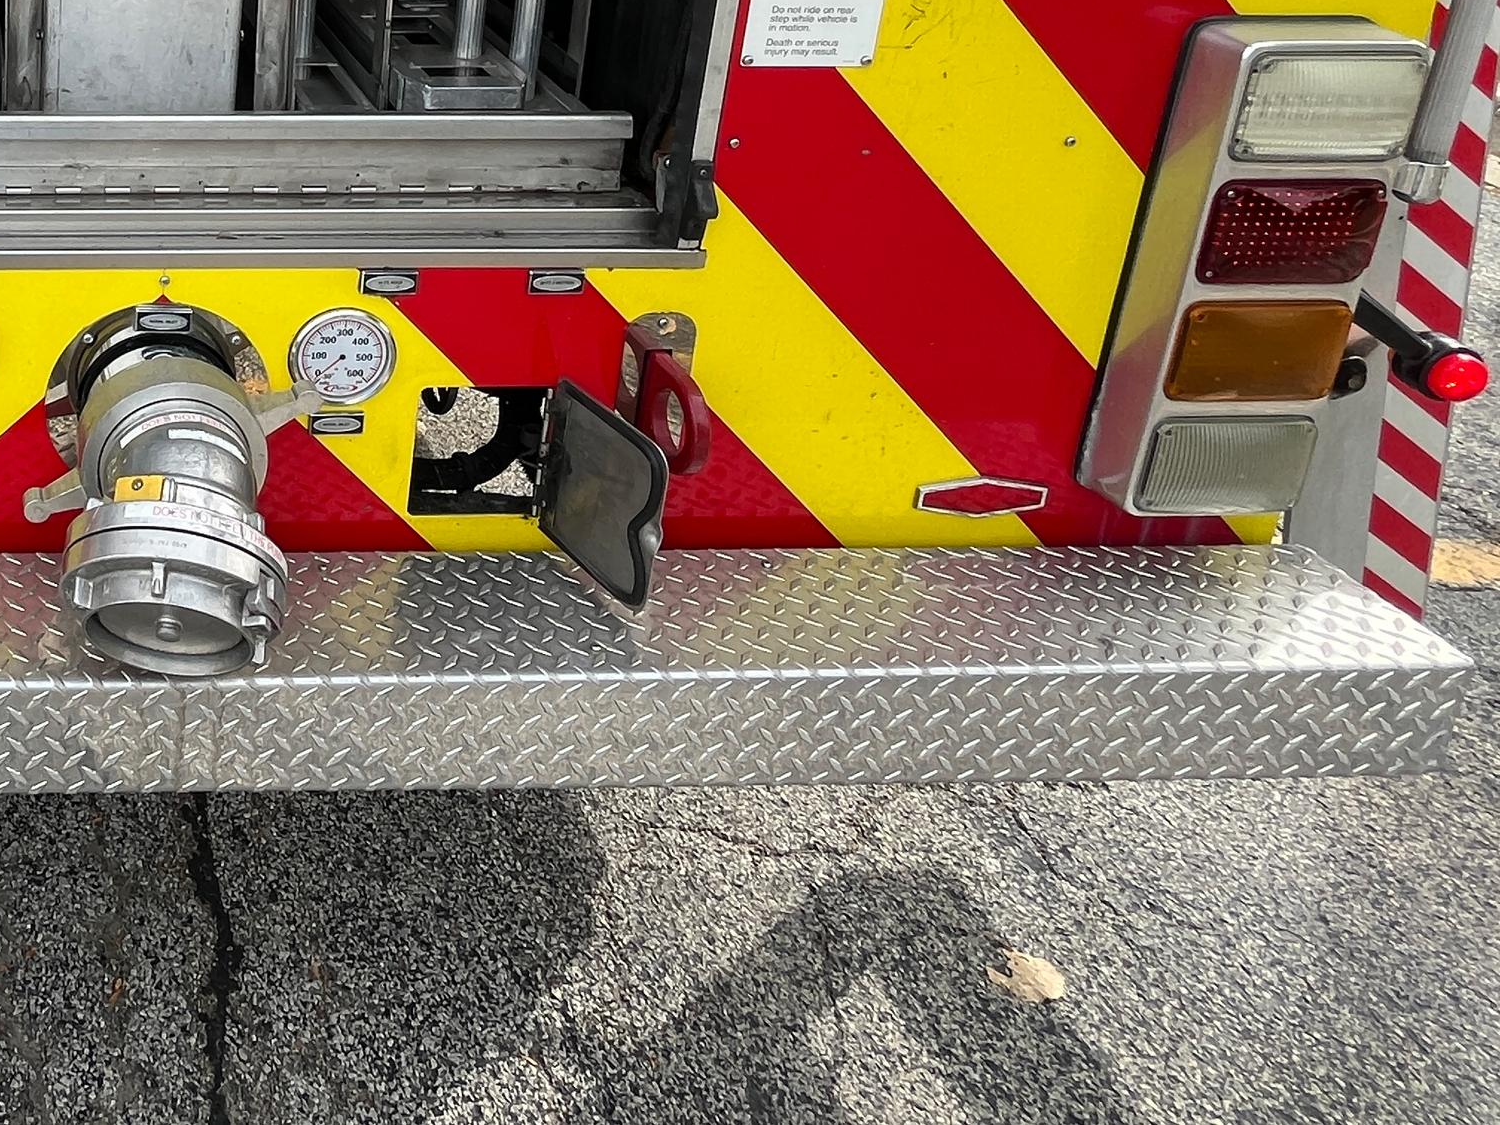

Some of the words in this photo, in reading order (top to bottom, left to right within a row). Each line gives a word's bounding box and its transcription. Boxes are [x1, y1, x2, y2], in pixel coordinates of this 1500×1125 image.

[772, 5, 785, 14] Do
[787, 6, 801, 14] not
[804, 6, 820, 14] ride
[770, 16, 789, 24] step
[766, 38, 793, 46] Death
[764, 48, 788, 57] injury
[791, 49, 810, 57] may
[337, 328, 353, 336] 300
[319, 336, 336, 344] 200
[314, 369, 321, 377] 0
[347, 369, 363, 377] 600
[152, 506, 187, 520] DOES
